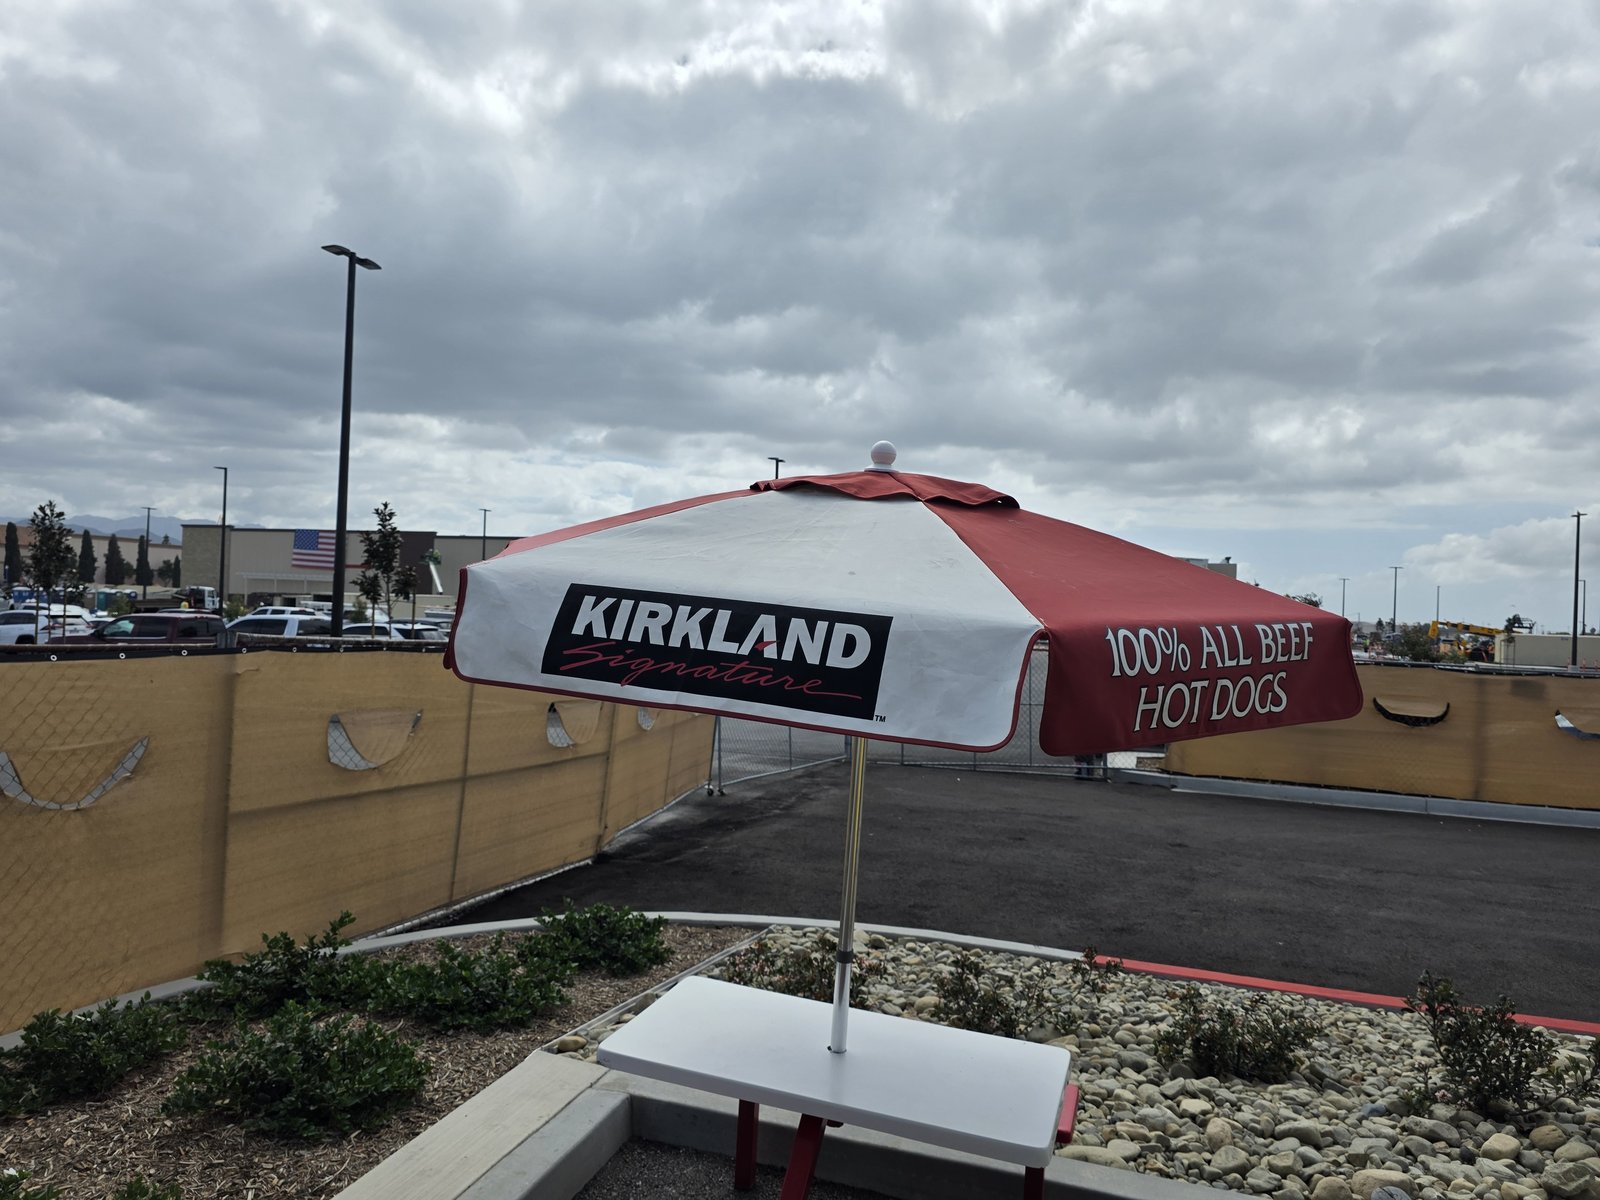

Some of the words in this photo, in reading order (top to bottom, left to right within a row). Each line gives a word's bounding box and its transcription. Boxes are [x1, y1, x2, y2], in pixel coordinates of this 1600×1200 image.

[571, 595, 871, 669] KIRKLAND
[1105, 625, 1191, 677] 100%
[1200, 625, 1252, 669] ALL
[1255, 622, 1313, 664] BEEF
[560, 642, 862, 699] Signature
[1134, 680, 1209, 731] HOT
[1210, 672, 1287, 721] DOGS
